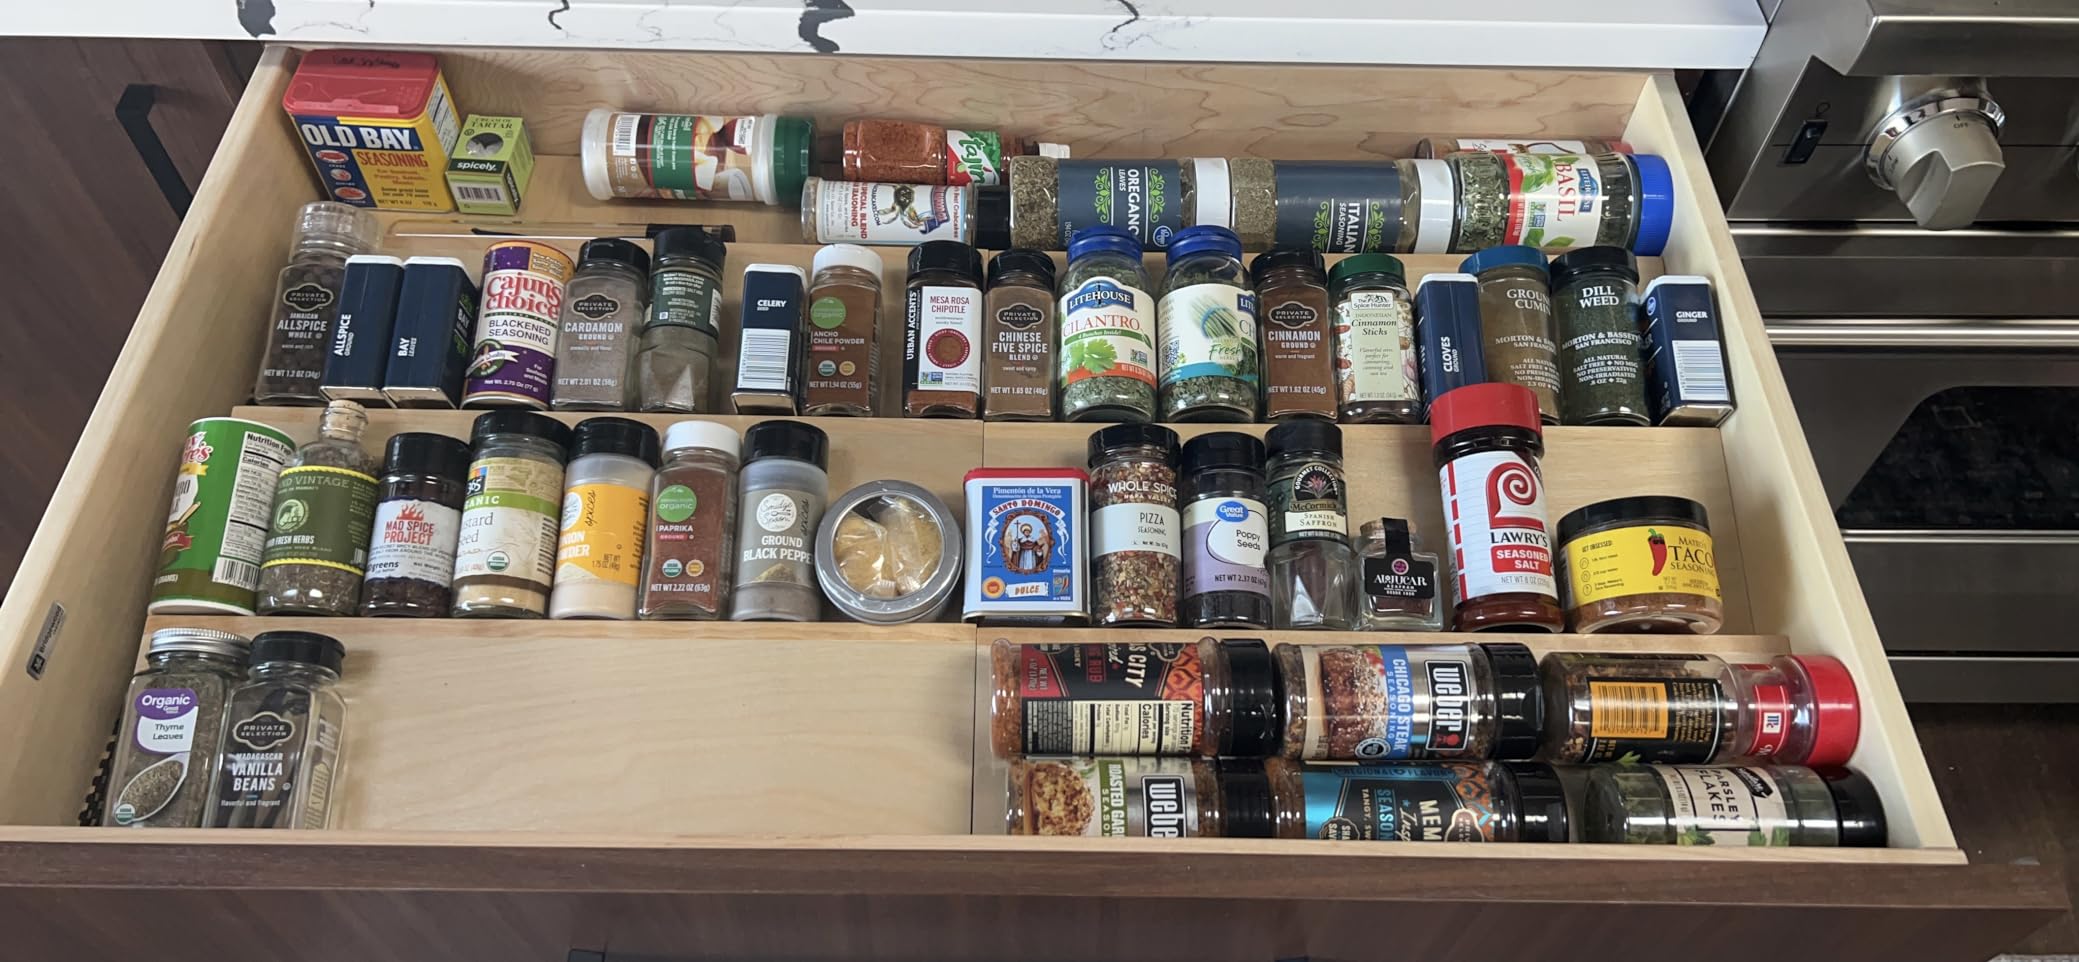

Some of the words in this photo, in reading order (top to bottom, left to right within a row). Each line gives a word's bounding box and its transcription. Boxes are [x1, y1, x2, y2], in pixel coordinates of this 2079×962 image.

[471, 121, 514, 130] TARTAR
[301, 124, 358, 148] OLD
[360, 127, 412, 150] BAY
[357, 151, 428, 168] SEASONING
[1118, 169, 1127, 192] LEAVES
[1555, 162, 1576, 222] BASIL
[860, 212, 868, 239] BLEND
[1336, 203, 1347, 246] SEASONING
[1343, 203, 1360, 253] ITALIAN
[487, 272, 562, 307] Cajun's
[1582, 286, 1616, 298] DILL
[486, 292, 559, 320] choice
[757, 300, 787, 308] CELERY
[930, 295, 950, 304] MESA
[951, 296, 970, 305] ROSA
[1069, 290, 1131, 309] LITEHOUSE
[1579, 296, 1619, 309] WEED
[908, 291, 917, 328] ACCENTS
[931, 305, 967, 314] CHIPOTLE
[1676, 311, 1708, 319] GINGER
[457, 309, 470, 327] BAY
[1351, 319, 1397, 328] Cinnamon
[277, 320, 327, 331] ALLSPICE
[489, 320, 551, 337] BLACKENED
[565, 322, 623, 332] CARDAMOM
[1063, 314, 1140, 338] CILANTRO
[1362, 327, 1388, 336] Sticks
[334, 314, 352, 356] ALLSPICE
[488, 329, 549, 346] SEASONING
[999, 332, 1041, 342] CHINESE
[1268, 331, 1321, 341] CINNAMON
[1495, 335, 1537, 345] MORTON
[1562, 333, 1596, 350] MORTON
[398, 338, 410, 357] BAY
[906, 329, 915, 361] URBAN
[992, 342, 1016, 353] FIVE
[1018, 343, 1048, 353] SPICE
[1210, 343, 1241, 355] Fresh
[1575, 341, 1590, 350] SAN
[1591, 339, 1632, 347] FRANCISCO
[1441, 336, 1452, 373] CLOVES
[1573, 364, 1587, 373] SALT
[1587, 366, 1637, 375] PRESERVATIVES
[1578, 372, 1636, 383] NON-IRRADIATED
[247, 433, 280, 449] Nutrition
[294, 475, 350, 488] VINTAGE
[1295, 465, 1313, 490] GOURMET
[1314, 465, 1338, 495] COLLECTION
[466, 479, 481, 495] 365
[993, 487, 1026, 495] Pimentón
[1108, 480, 1149, 493] WHOLE
[1153, 482, 1178, 498] SPICE
[659, 503, 693, 511] organic
[992, 500, 1018, 516] SANTO
[1021, 500, 1061, 516] DOMINGO
[1219, 505, 1244, 515] Great
[1292, 502, 1337, 511] McCormick
[1140, 512, 1165, 526] PIZZA
[1304, 512, 1335, 520] SPANISH
[385, 521, 404, 532] MAD
[406, 521, 435, 533] SPICE
[1299, 519, 1337, 527] SAFFRON
[1137, 527, 1167, 536] SEASONING
[1236, 529, 1261, 541] Poppy
[275, 536, 292, 545] FRESH
[293, 535, 315, 545] HERBS
[384, 532, 433, 545] PROJECT
[761, 535, 803, 547] GROUND
[1236, 539, 1261, 551] Seeds
[1490, 531, 1548, 547] LAWRY'S
[744, 548, 777, 562] BLACK
[1496, 550, 1549, 562] SEASONED
[1668, 545, 1714, 568] TACO
[1514, 560, 1539, 570] SALT
[651, 584, 662, 592] NET
[663, 584, 673, 592] WT
[674, 584, 685, 592] 2.22
[686, 584, 694, 592] OZ
[1014, 585, 1040, 595] DULCE
[1088, 660, 1103, 683] RUB
[1124, 653, 1148, 688] CITY
[1393, 658, 1410, 713] CHICAGO
[141, 693, 191, 709] Organic
[1386, 671, 1394, 740] SEASONING
[1432, 667, 1462, 732] weber
[155, 723, 184, 732] Thyme
[1141, 703, 1152, 740] Calories
[1179, 703, 1192, 745] Nutrition
[153, 732, 184, 740] Leaves
[1395, 714, 1410, 751] STEAK
[236, 753, 283, 761] MADAGASCAR
[232, 763, 283, 776] VANILLA
[233, 778, 276, 791] BEANS
[1108, 763, 1123, 808] ROASTED
[1697, 768, 1726, 822] FLAKES
[1711, 768, 1742, 822] PARSLEY
